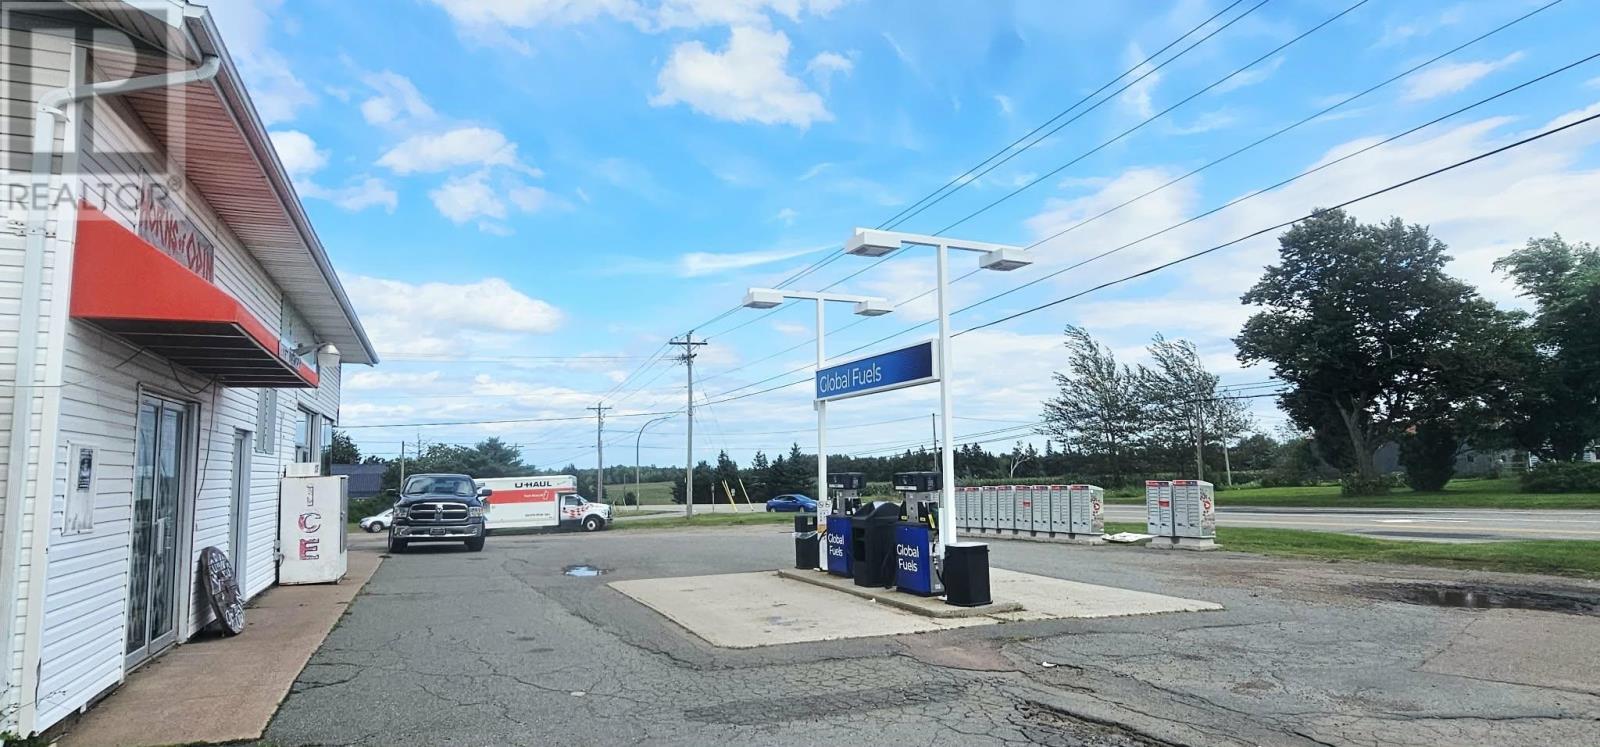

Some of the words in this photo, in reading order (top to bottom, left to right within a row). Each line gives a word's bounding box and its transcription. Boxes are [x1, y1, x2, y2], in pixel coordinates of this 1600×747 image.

[819, 369, 850, 394] Global
[853, 362, 882, 387] Fuels
[298, 485, 321, 560] ICE
[828, 533, 845, 545] Global
[829, 545, 843, 557] Fuels
[896, 544, 919, 558] Global
[898, 558, 918, 572] Fuels
